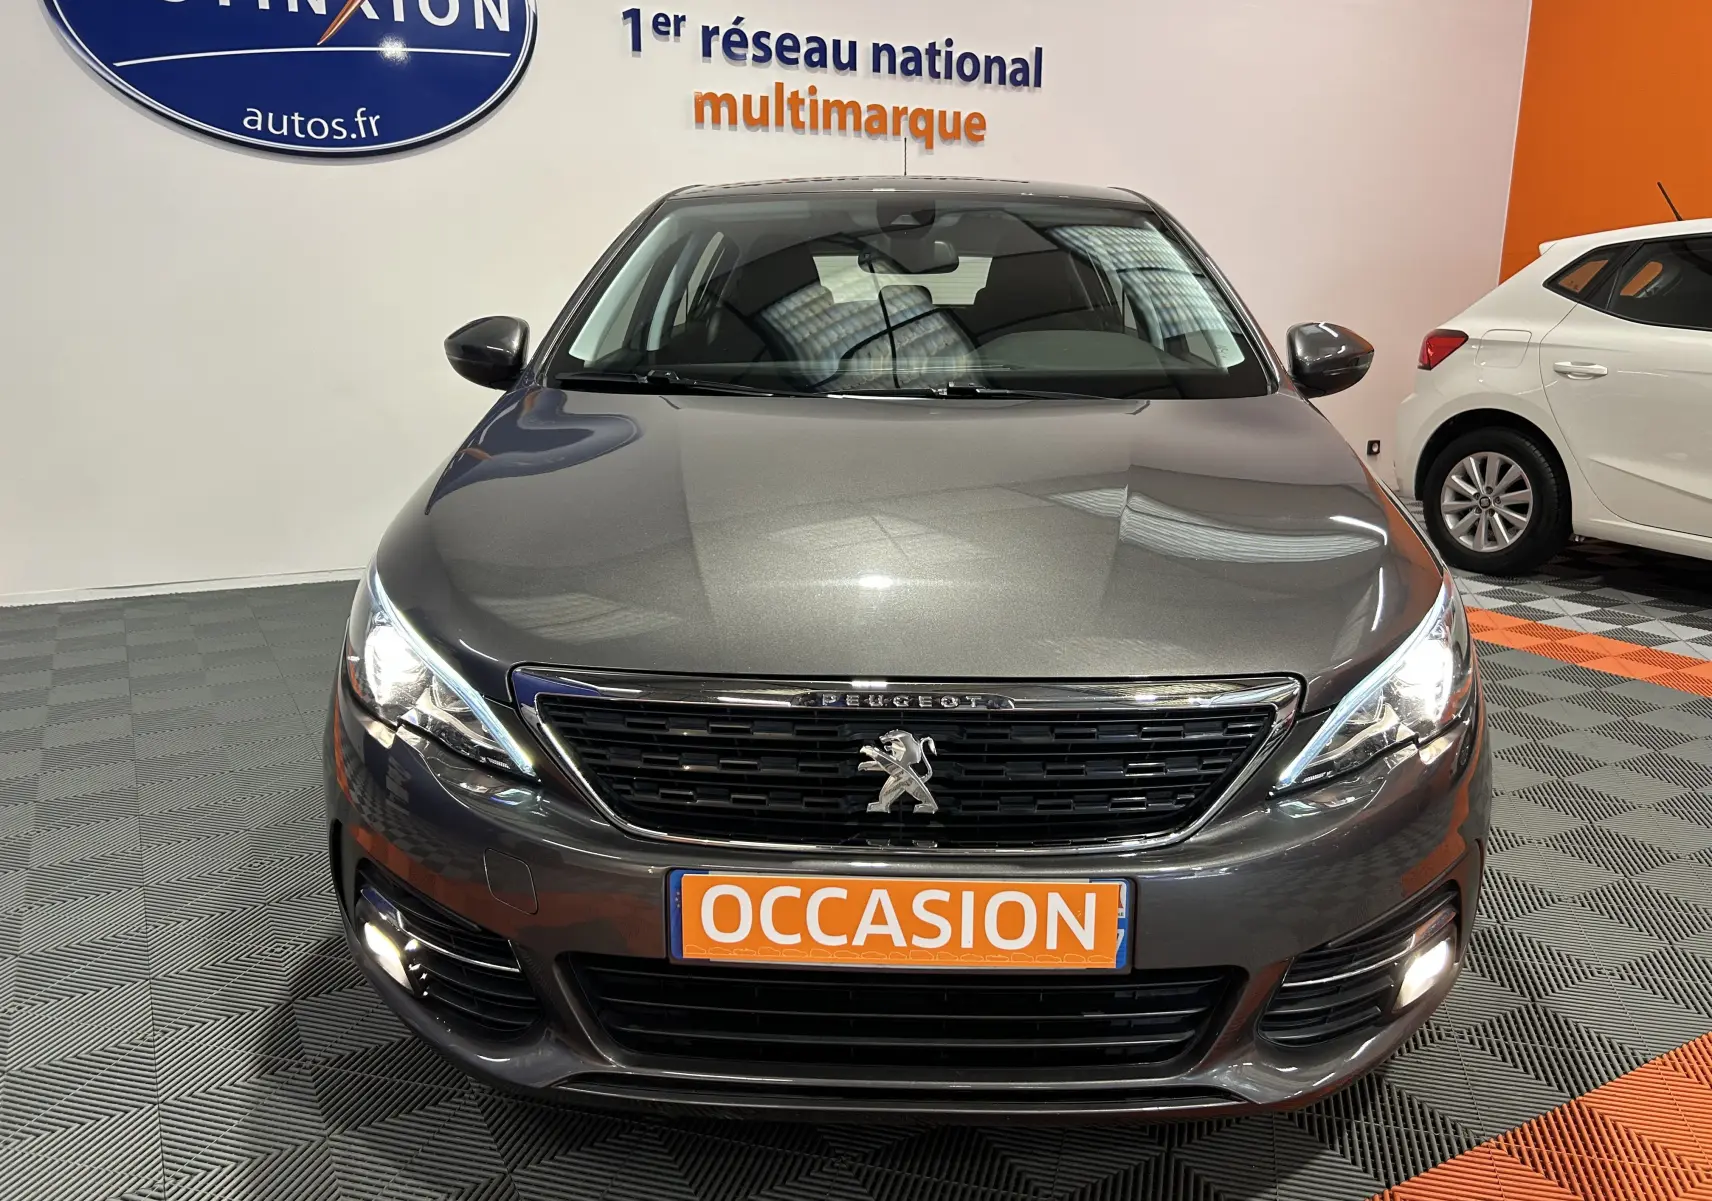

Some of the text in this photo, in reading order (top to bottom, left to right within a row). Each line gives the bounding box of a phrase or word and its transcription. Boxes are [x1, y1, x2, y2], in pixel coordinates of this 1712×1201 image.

[622, 8, 1043, 88] 1er réseau national
[243, 107, 380, 141] autos.fr
[694, 82, 987, 150] multimarque
[821, 693, 982, 708] PEUGEOT
[701, 884, 1097, 951] OCCASION
